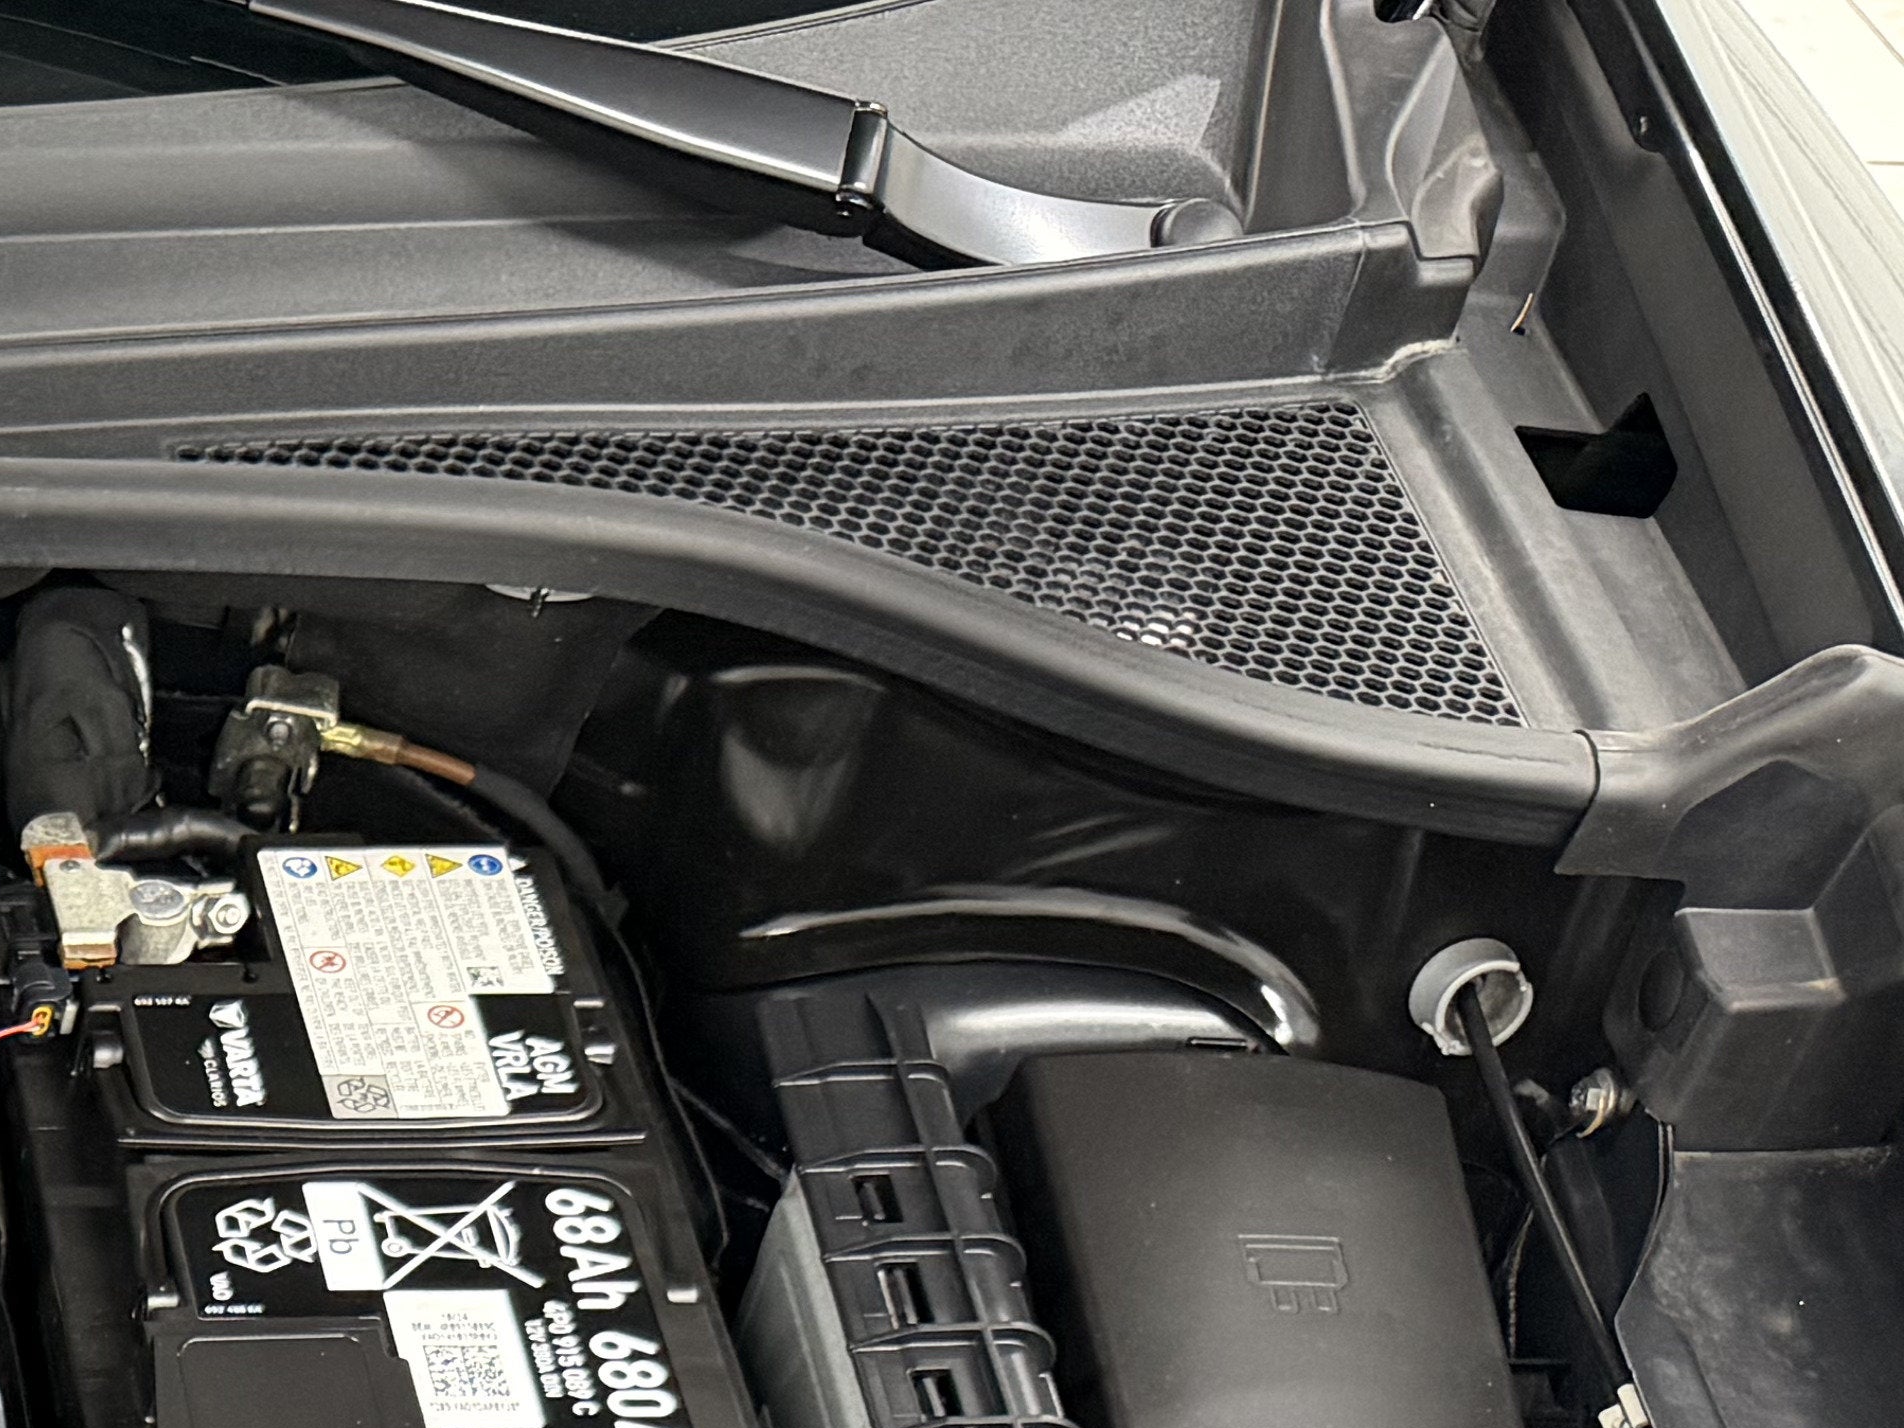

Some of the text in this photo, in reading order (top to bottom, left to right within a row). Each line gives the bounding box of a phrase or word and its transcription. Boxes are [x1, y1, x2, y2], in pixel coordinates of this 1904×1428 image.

[515, 876, 565, 976] DANGER/POISON
[204, 1060, 228, 1107] CLARIOS
[220, 1026, 265, 1107] VARTA
[489, 1029, 541, 1101] VRLA
[525, 1035, 581, 1094] AGM
[323, 1220, 359, 1254] Pb
[545, 1188, 642, 1310] 68Ah
[552, 1335, 585, 1368] 915
[572, 1401, 601, 1416] C
